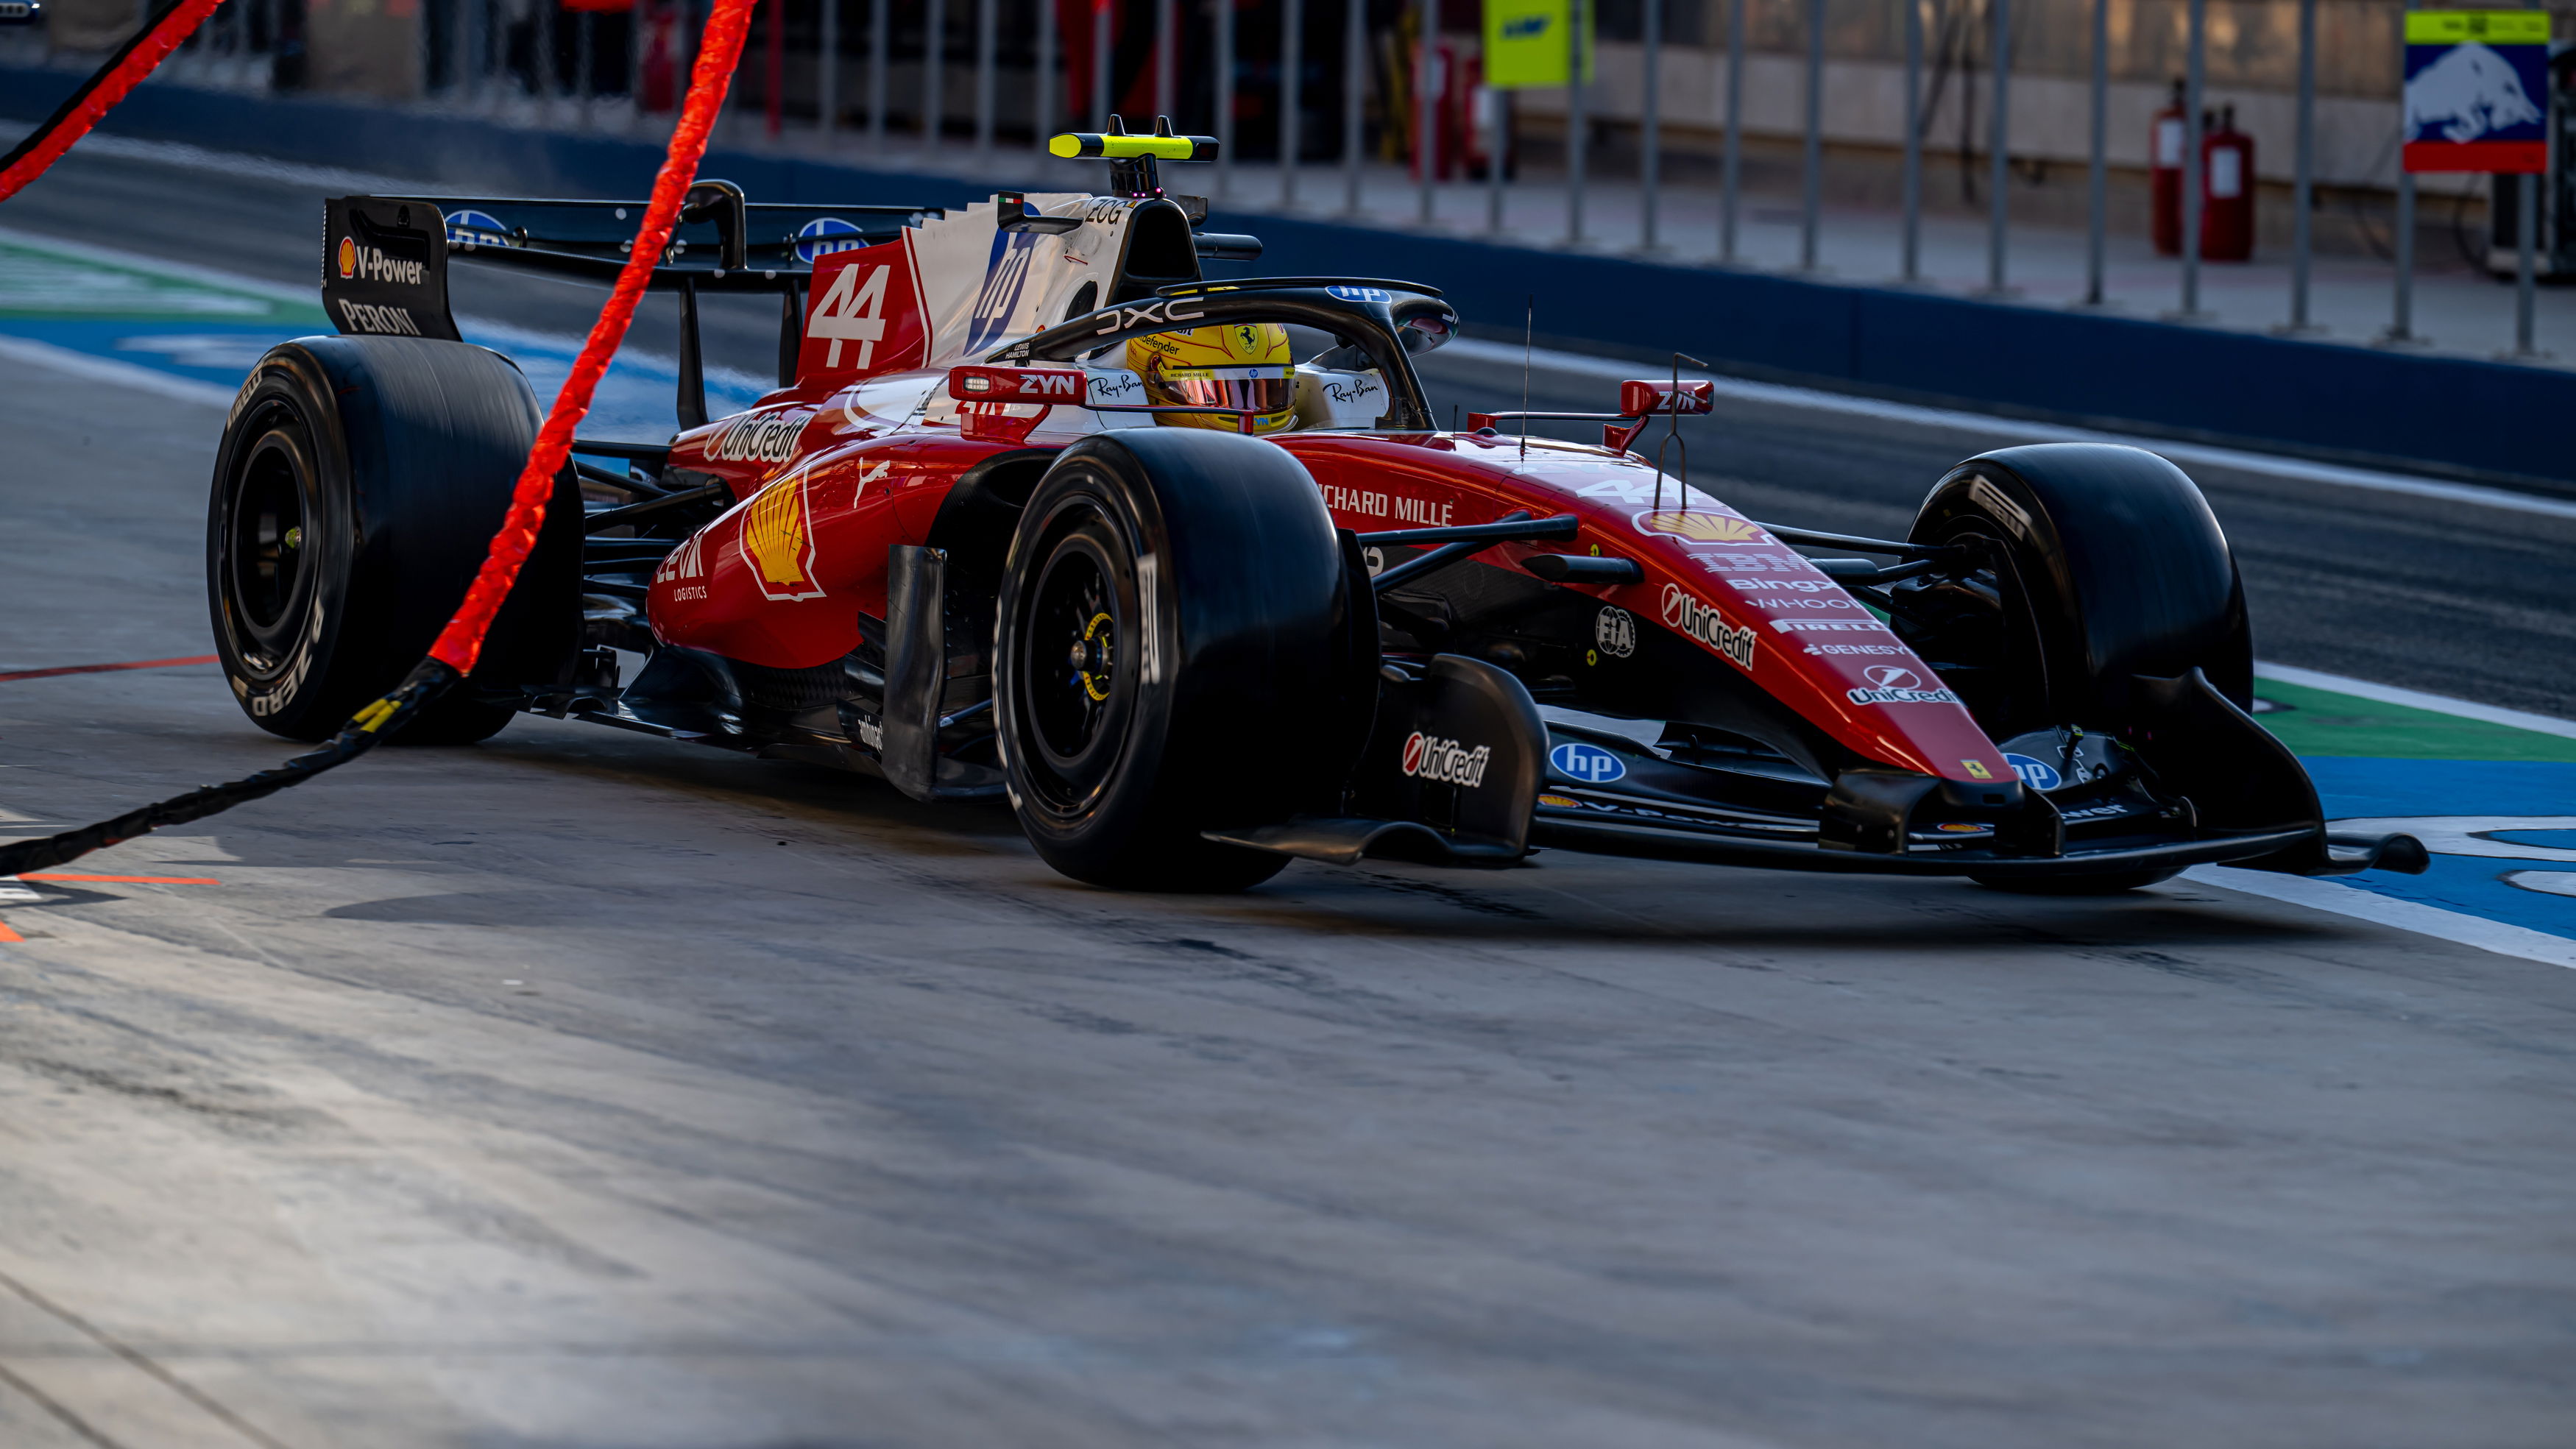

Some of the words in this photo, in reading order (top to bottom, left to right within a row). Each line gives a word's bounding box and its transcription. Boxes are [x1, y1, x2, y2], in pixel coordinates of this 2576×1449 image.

[1085, 199, 1128, 224] ZCG
[357, 245, 422, 286] V-Power
[339, 298, 422, 336] PERONI
[807, 263, 891, 369] 44
[1096, 297, 1205, 336] DXC
[1005, 349, 1029, 359] HAMILTON
[1014, 342, 1030, 351] LEWIS
[1137, 335, 1180, 355] defender
[1019, 374, 1075, 394] ZYN
[1323, 379, 1379, 403] Ray-Ban
[1657, 391, 1696, 410] ZYN
[1253, 417, 1269, 426] YN
[722, 411, 813, 461] UniCredit
[1576, 479, 1704, 505] 44
[1319, 483, 1389, 517] ICHARD
[1395, 496, 1454, 528] MILLE
[1687, 553, 1821, 573] IBM
[673, 585, 707, 602] LOGISTICS
[1681, 594, 1758, 670] UniCredit
[1768, 618, 1888, 634] PIRELL
[1821, 645, 1917, 658] GENESY
[1847, 687, 1964, 705] UniCredi
[1419, 736, 1490, 787] UniCredit
[1565, 744, 1614, 782] hp
